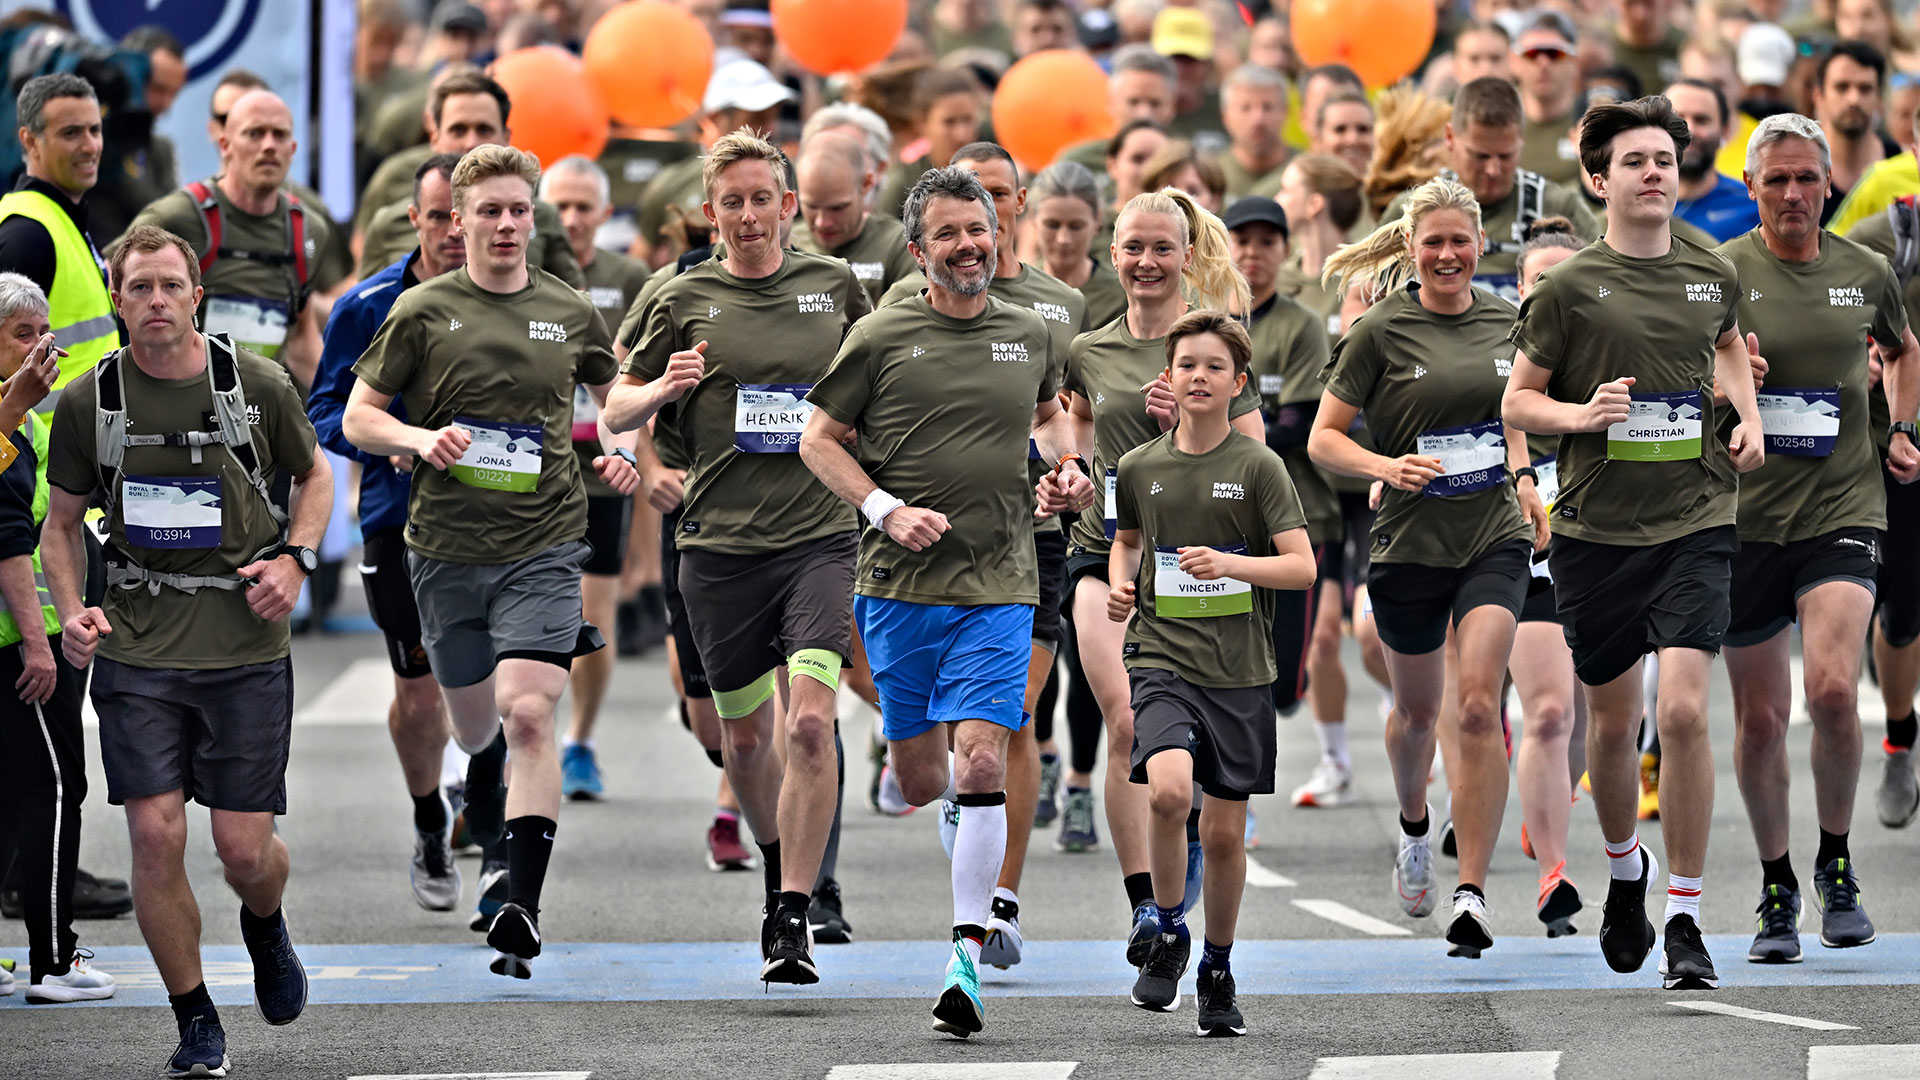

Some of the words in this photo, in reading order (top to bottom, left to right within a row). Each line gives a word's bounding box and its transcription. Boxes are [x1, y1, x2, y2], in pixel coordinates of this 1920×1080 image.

[1685, 283, 1722, 293] ROYAL
[1828, 287, 1864, 298] ROYAL
[797, 293, 833, 304] ROYAL
[529, 321, 567, 334] ROYAL
[991, 342, 1028, 353] ROYAL
[746, 412, 804, 426] HENRIK
[1628, 428, 1685, 438] CHRISTIAN
[762, 433, 801, 445] 10295
[1773, 436, 1816, 449] 102548
[1653, 443, 1661, 454] 3
[475, 456, 513, 468] JONAS
[473, 469, 513, 483] 101224
[1447, 471, 1489, 488] 103088
[1213, 482, 1245, 492] ROYAL
[150, 529, 192, 542] 103914
[1178, 583, 1227, 593] VINCENT
[1199, 598, 1209, 609] 5
